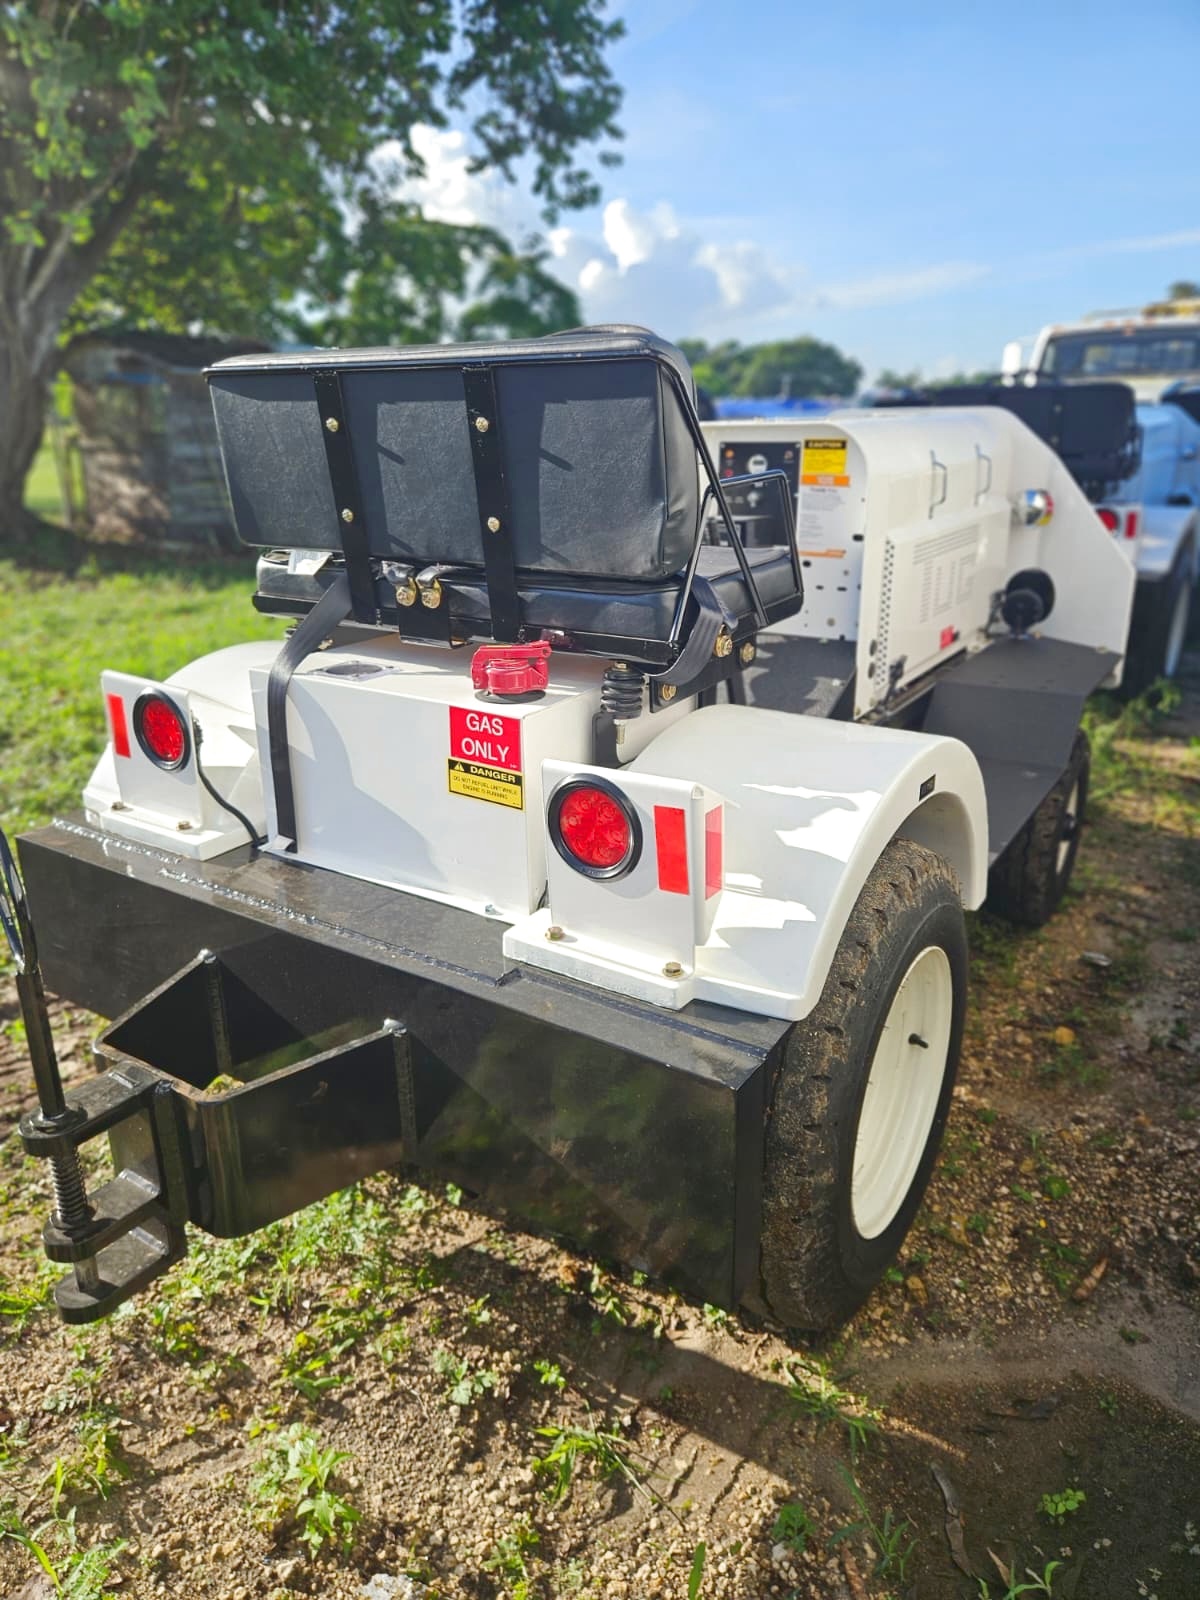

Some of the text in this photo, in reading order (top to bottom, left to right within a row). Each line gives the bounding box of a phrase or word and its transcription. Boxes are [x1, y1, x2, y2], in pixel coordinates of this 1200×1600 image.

[466, 713, 504, 736] GAS
[461, 737, 510, 763] ONLY
[470, 766, 516, 783] DANGER
